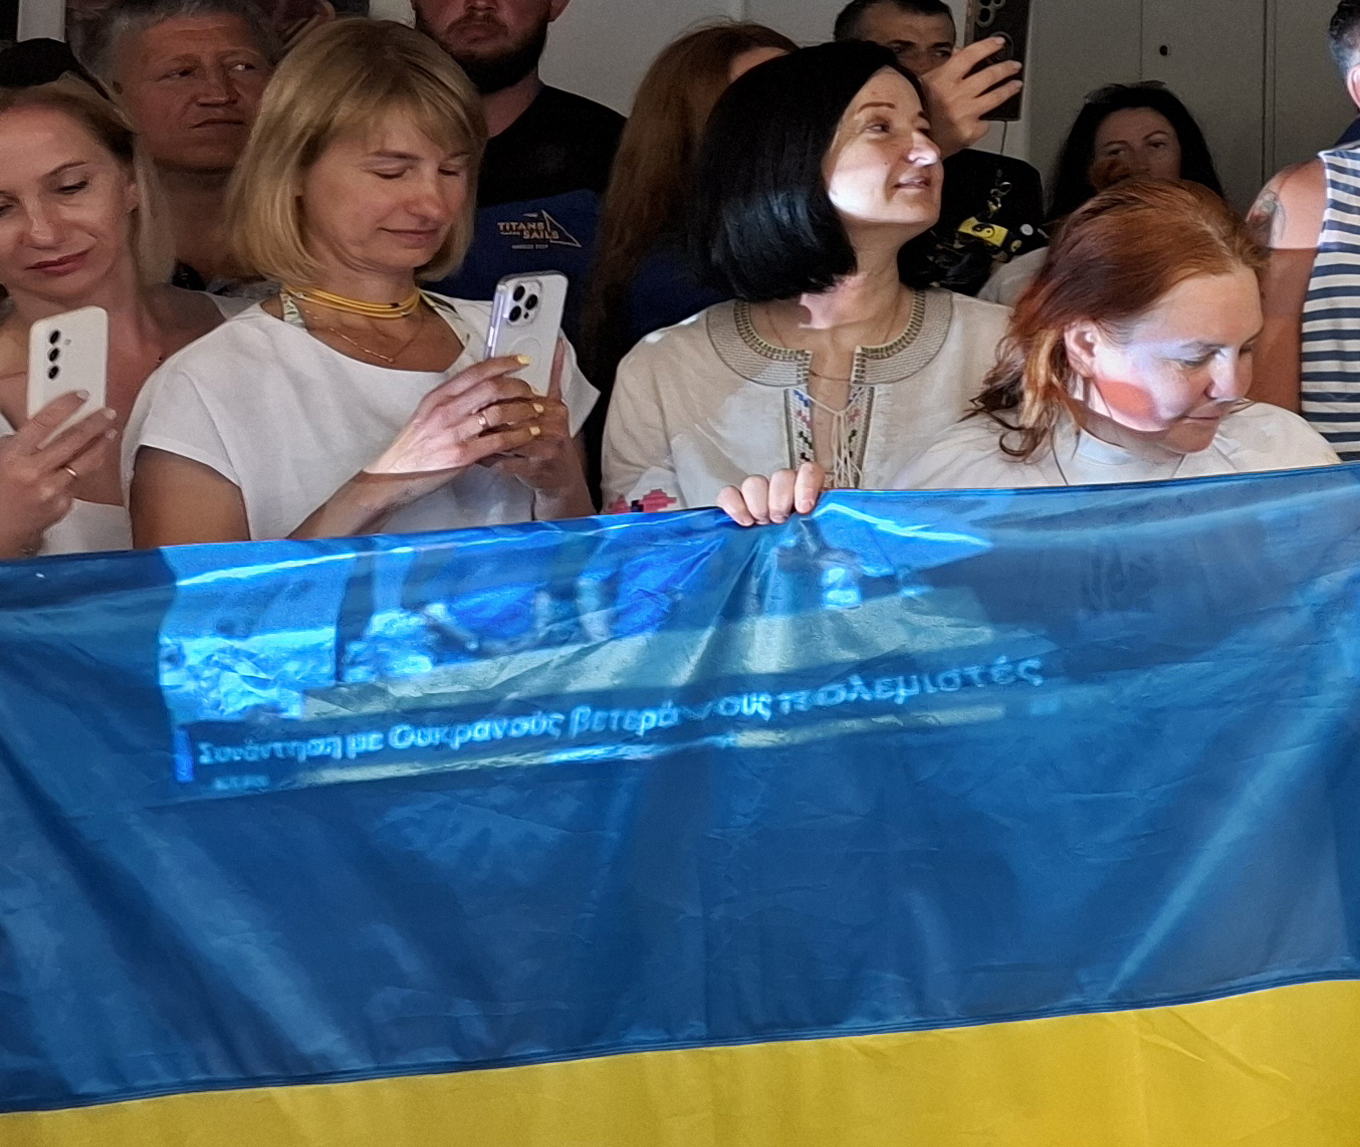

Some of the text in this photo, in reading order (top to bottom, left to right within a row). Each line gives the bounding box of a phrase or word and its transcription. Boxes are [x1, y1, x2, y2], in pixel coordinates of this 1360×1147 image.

[497, 221, 545, 231] TITANS
[523, 230, 560, 240] SAILS
[347, 731, 384, 760] με
